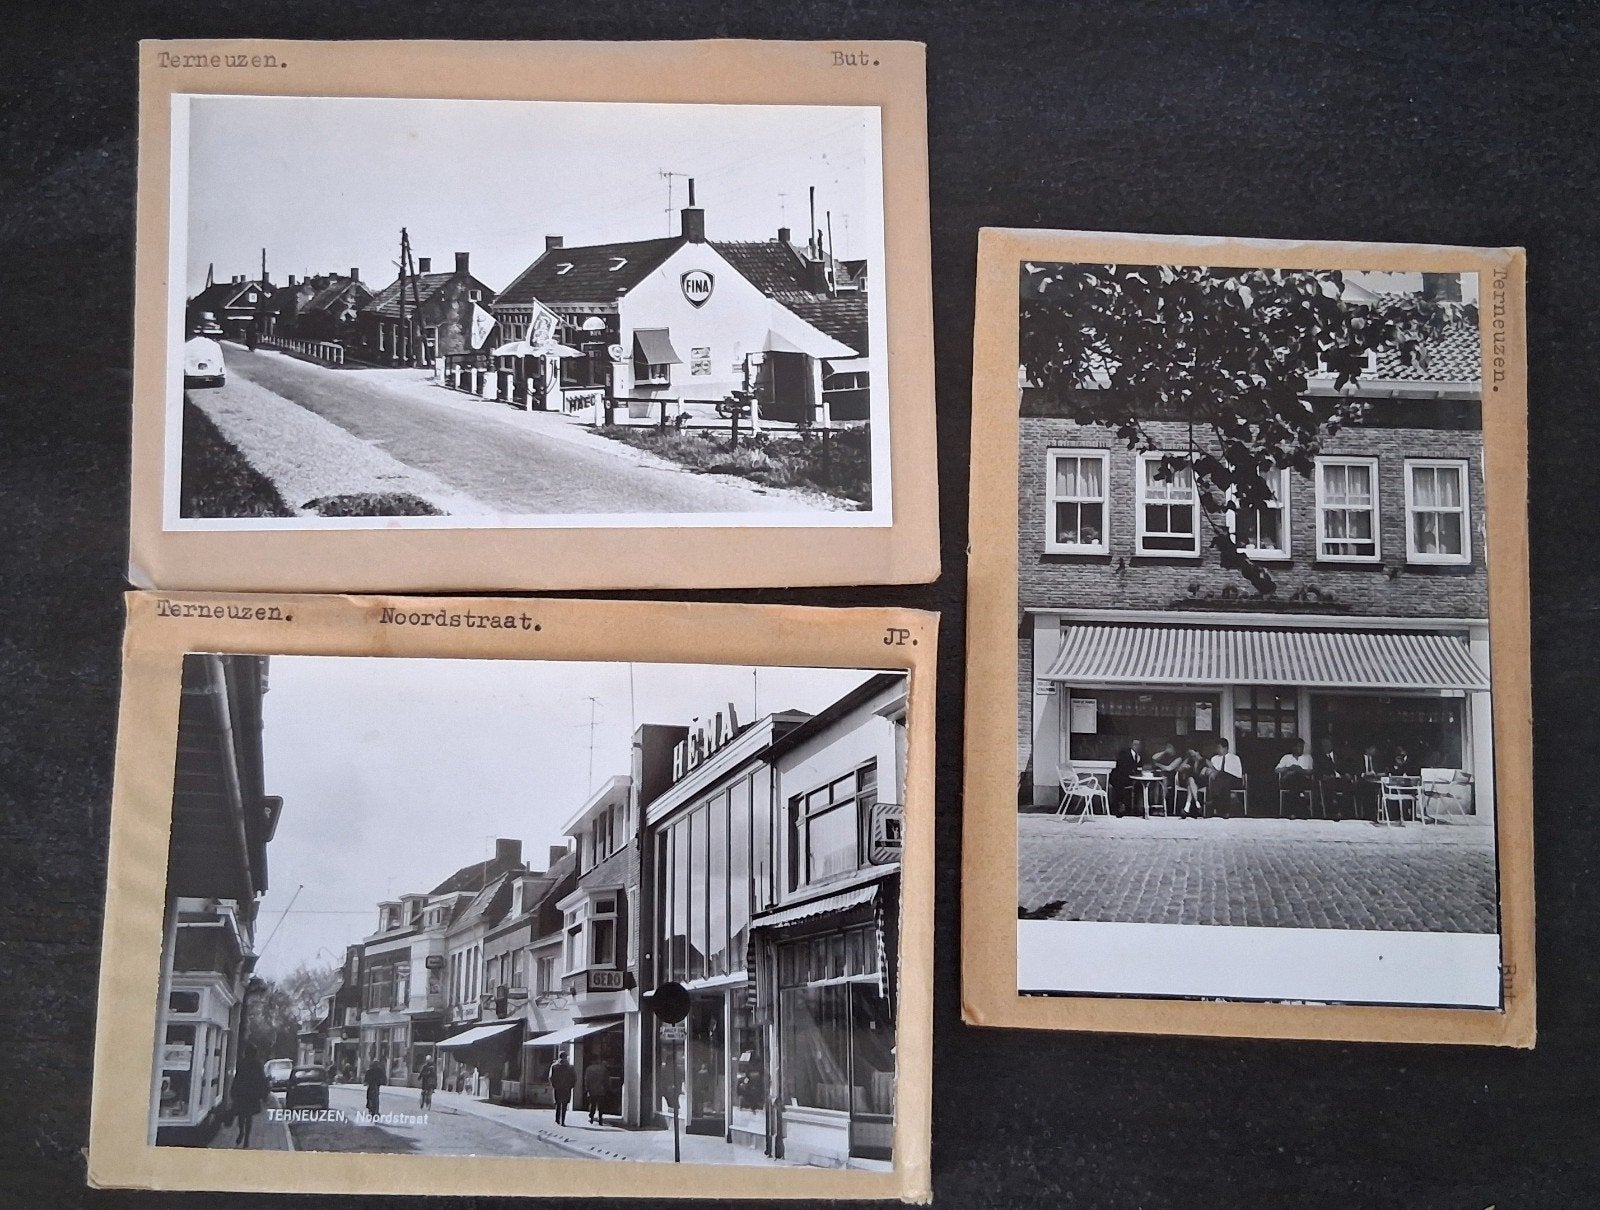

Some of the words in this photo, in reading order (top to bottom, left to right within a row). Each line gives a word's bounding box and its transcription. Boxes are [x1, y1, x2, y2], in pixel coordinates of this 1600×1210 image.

[157, 51, 288, 68] Terneuzen.
[832, 50, 880, 66] But.
[686, 279, 709, 293] FINA
[157, 599, 293, 622] Terneuzen.
[379, 607, 542, 632] Noordstraat.
[883, 627, 918, 646] JP.
[672, 702, 740, 783] HEMA
[266, 1108, 348, 1124] TERNEUZEN,
[356, 1110, 429, 1125] Noordstraat
